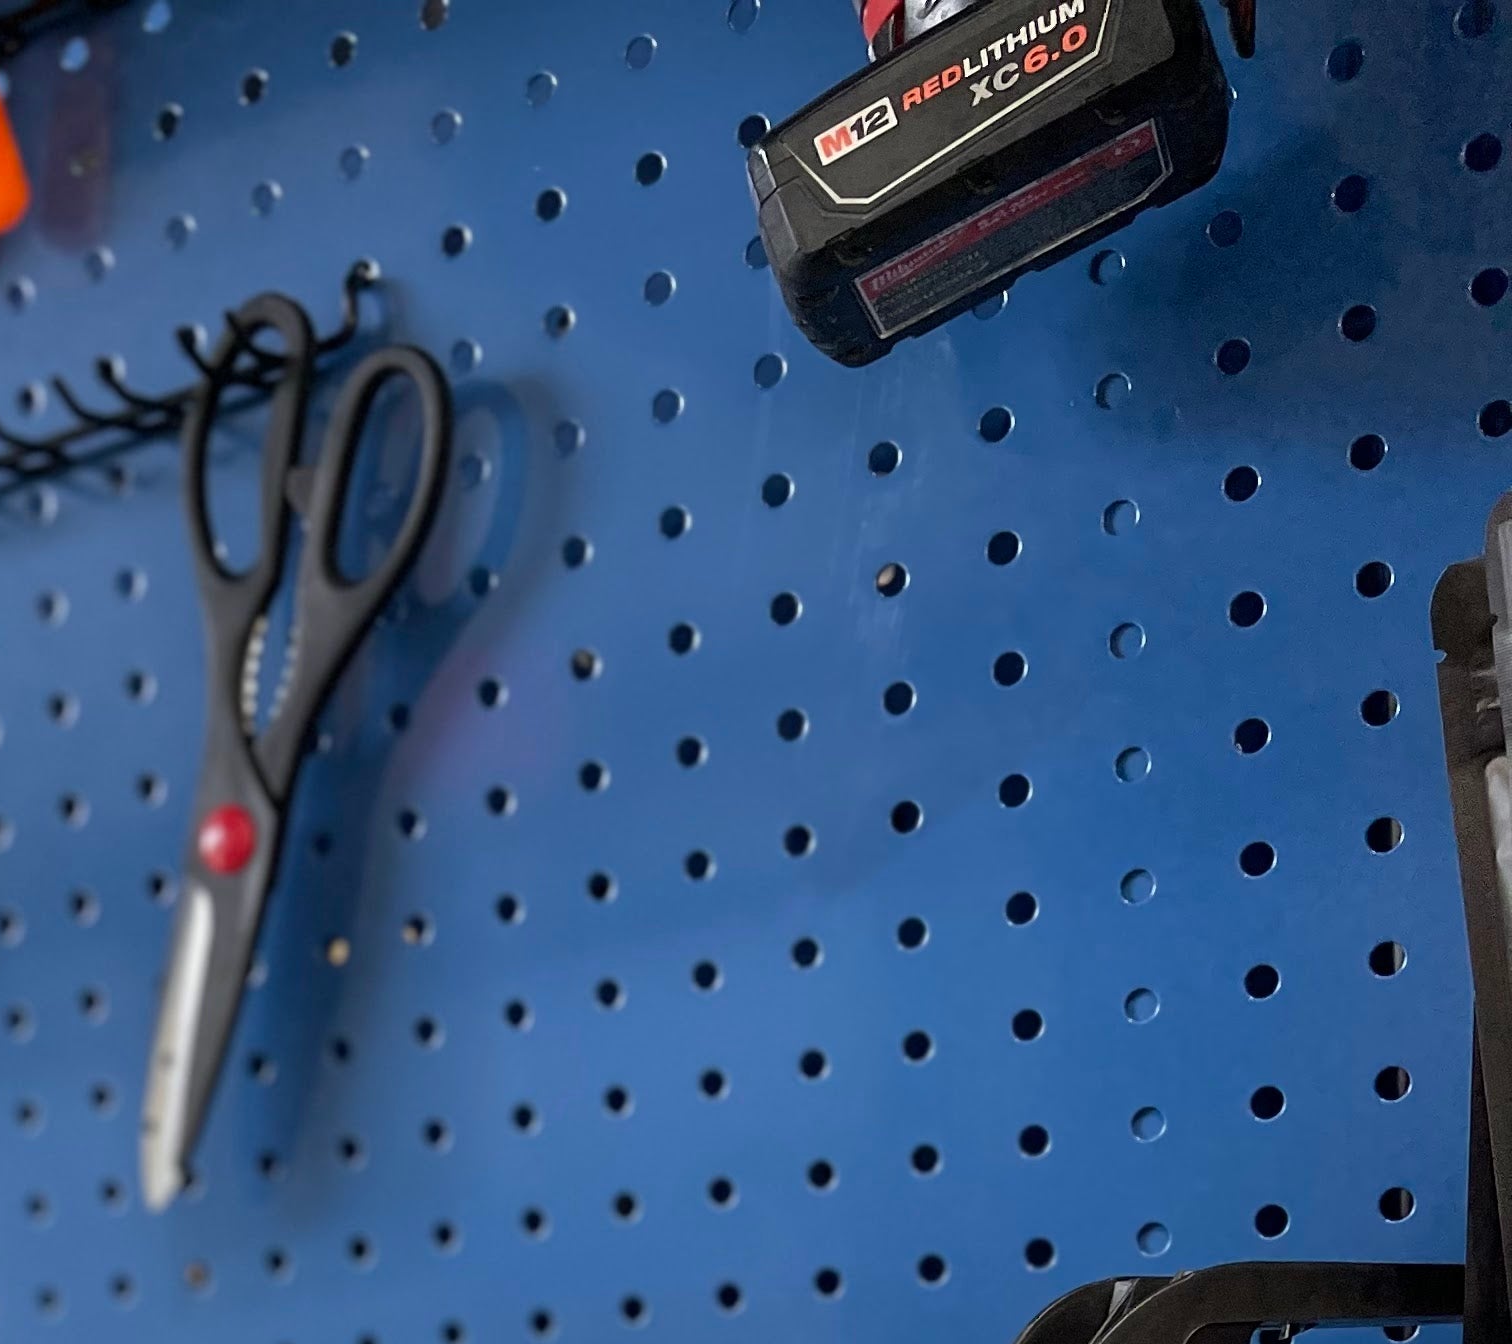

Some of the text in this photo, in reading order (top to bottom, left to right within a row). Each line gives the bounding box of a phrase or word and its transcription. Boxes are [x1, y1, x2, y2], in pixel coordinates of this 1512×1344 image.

[818, 0, 1085, 159] M12 REDLITHIUM
[969, 24, 1088, 107] XC6.0
